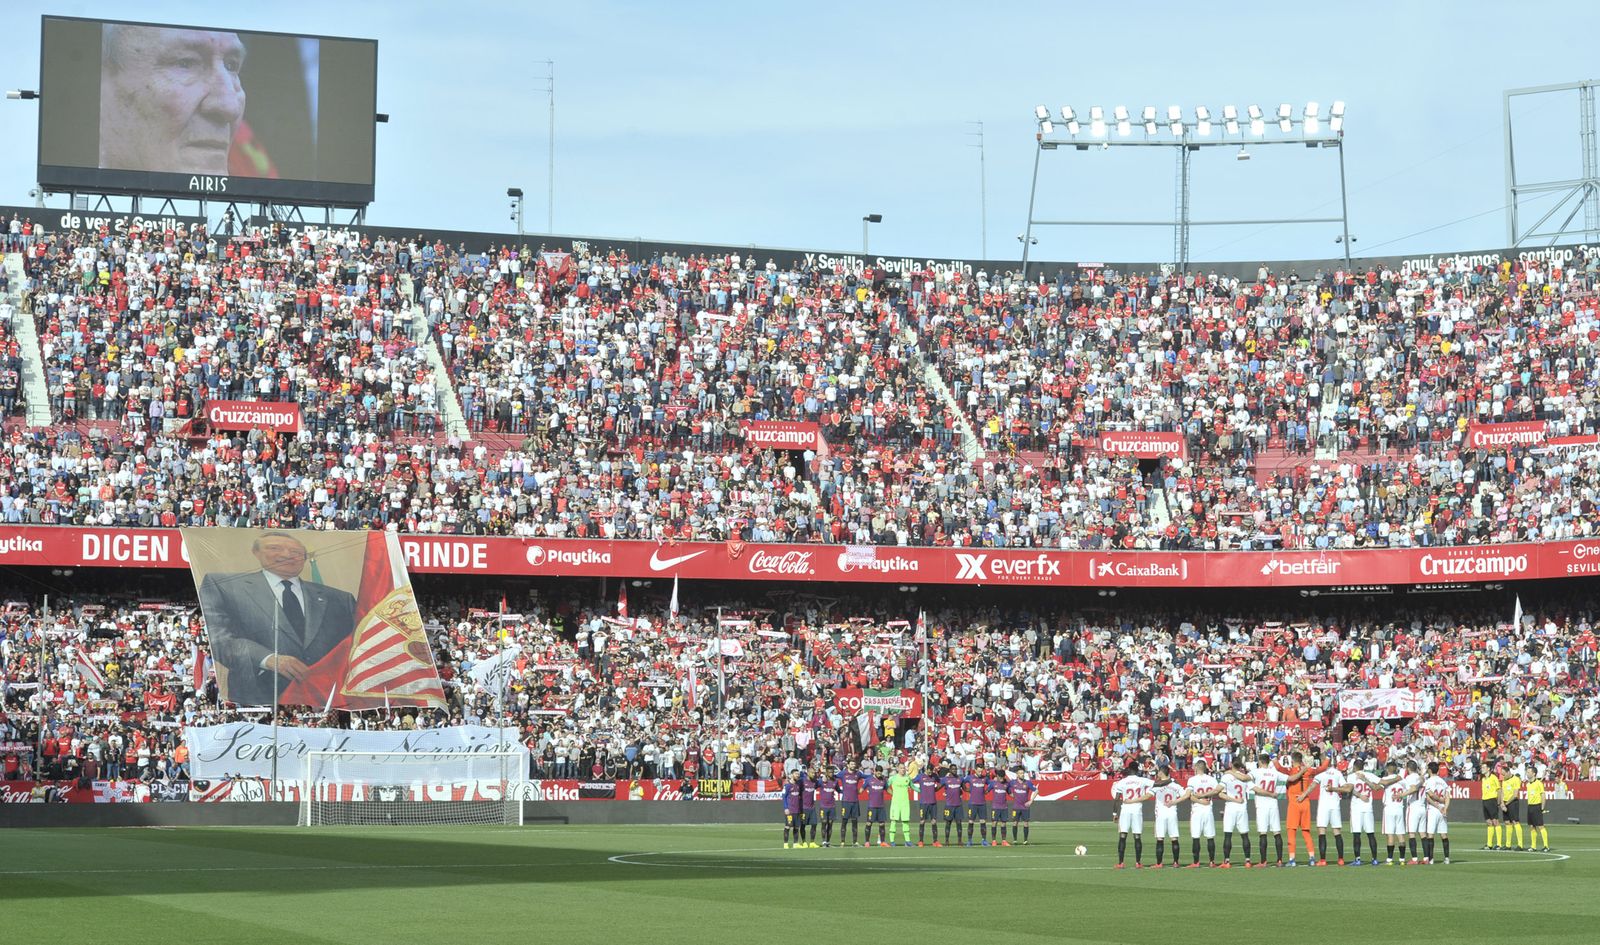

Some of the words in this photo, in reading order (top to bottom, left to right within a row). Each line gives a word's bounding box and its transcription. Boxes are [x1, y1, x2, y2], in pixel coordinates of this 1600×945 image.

[189, 176, 228, 192] AIRIS
[61, 212, 81, 229] de
[85, 216, 111, 230] ver
[805, 253, 815, 267] Y
[210, 406, 294, 427] Cruzcampo
[1103, 437, 1179, 453] Cruzcampo
[82, 534, 169, 562] DICEN
[404, 541, 488, 568] RINDE
[548, 548, 611, 565] Playtika
[749, 550, 813, 575] Coca-Cola
[990, 554, 1060, 575] everfx
[1420, 553, 1528, 576] Cruzcampo
[1115, 563, 1180, 576] CaixaBank
[1279, 559, 1341, 575] betfair
[197, 722, 311, 762] Señor
[1126, 788, 1141, 800] 21
[1234, 784, 1243, 800] 3
[1260, 780, 1275, 795] 14
[1355, 783, 1372, 798] 25
